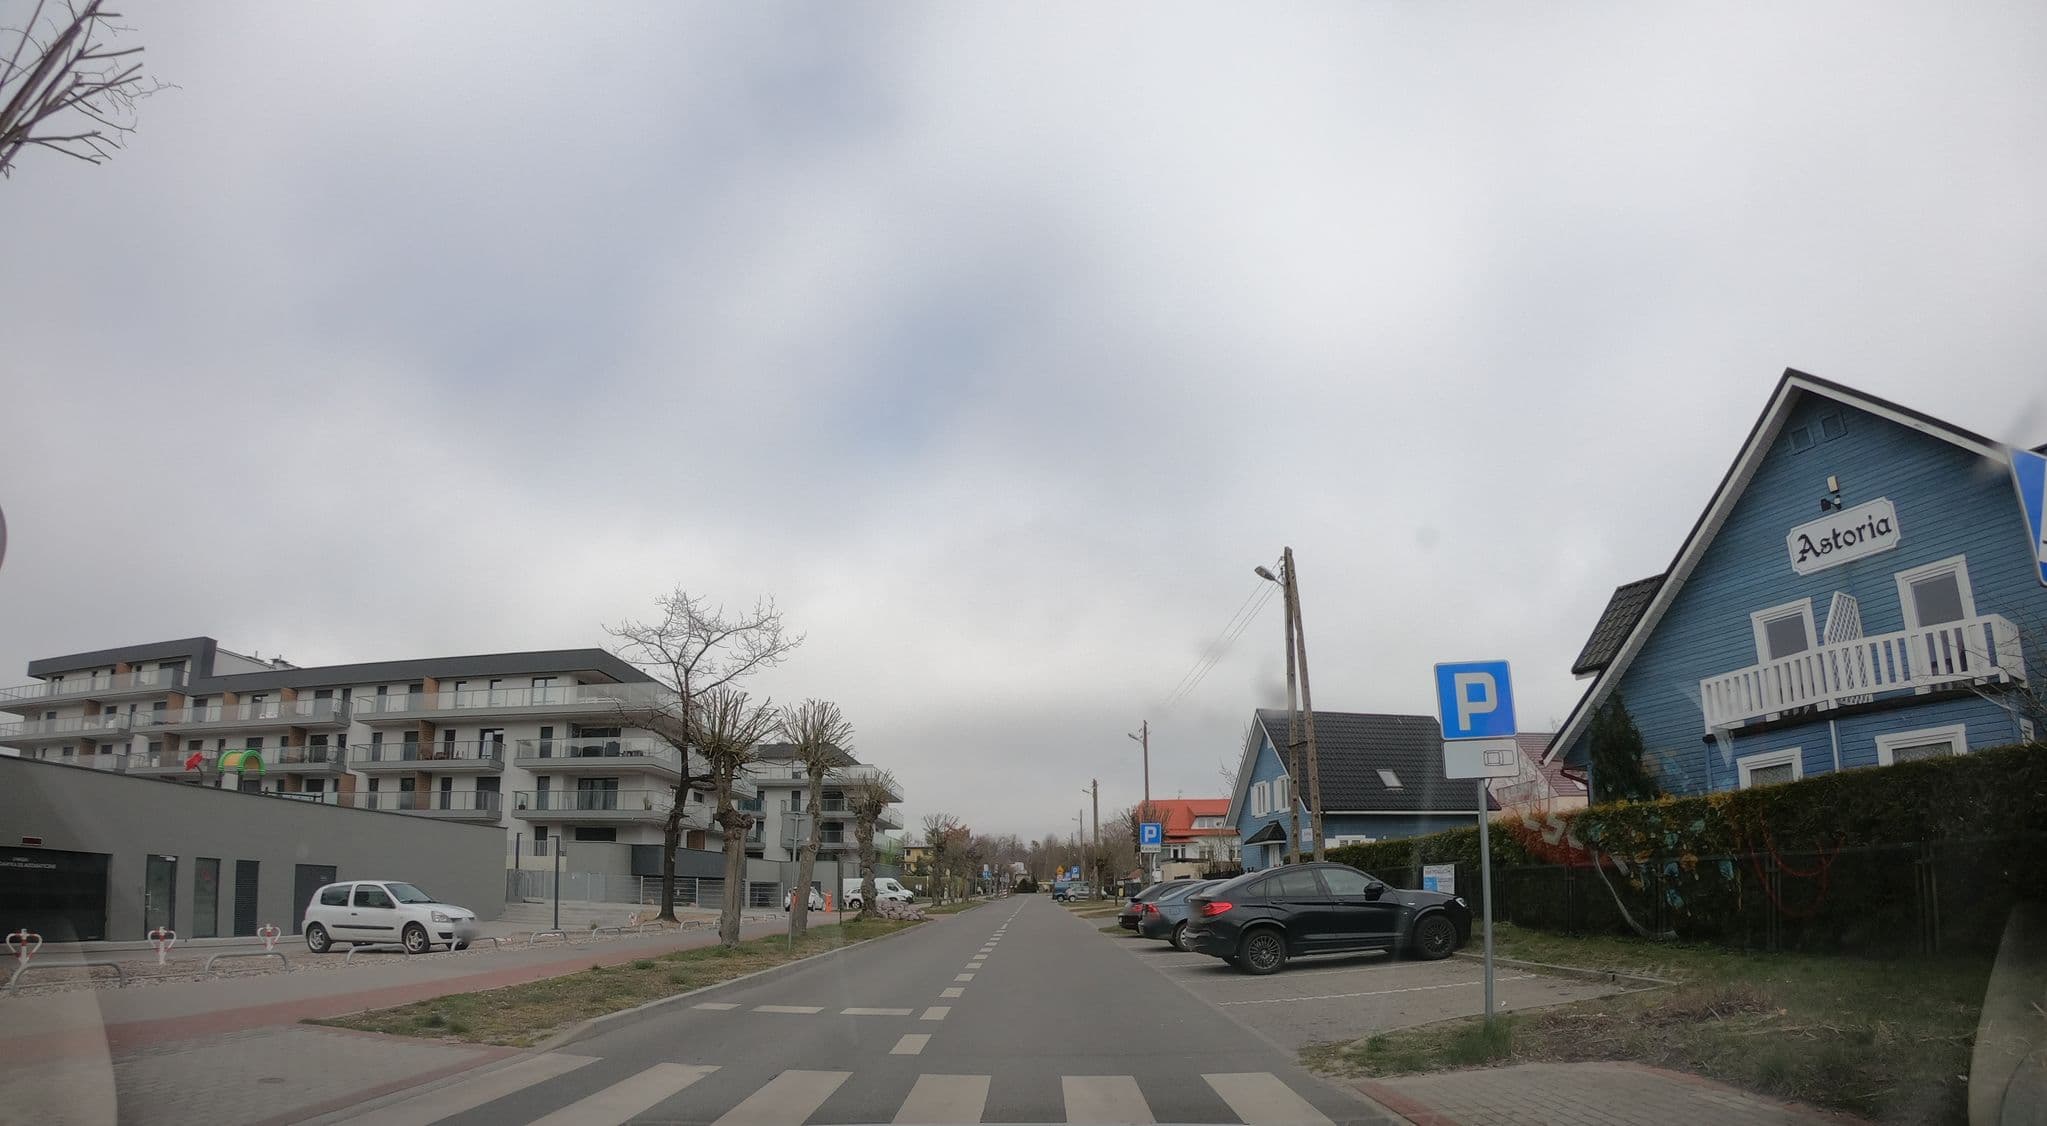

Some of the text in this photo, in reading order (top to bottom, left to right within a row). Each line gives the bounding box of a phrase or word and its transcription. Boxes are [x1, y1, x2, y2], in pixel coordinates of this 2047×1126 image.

[1797, 515, 1892, 564] Astoria
[1454, 672, 1498, 731] P
[1145, 826, 1157, 842] P
